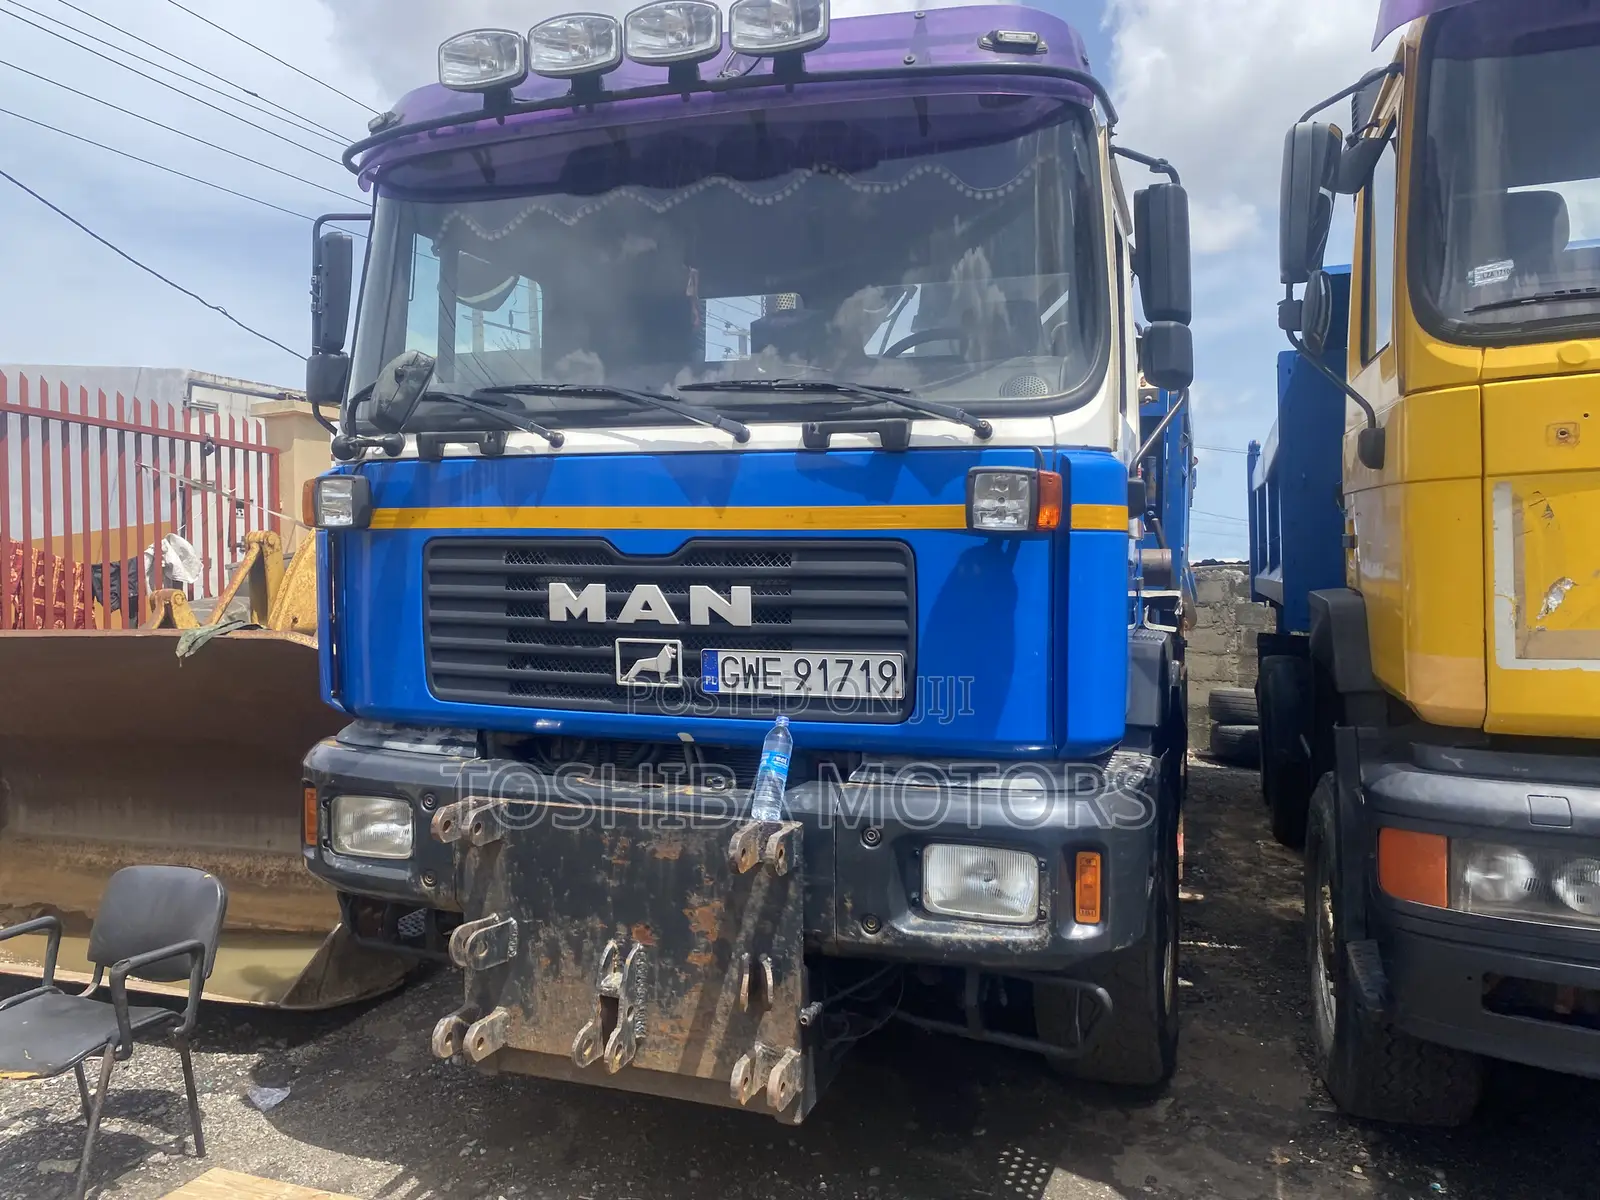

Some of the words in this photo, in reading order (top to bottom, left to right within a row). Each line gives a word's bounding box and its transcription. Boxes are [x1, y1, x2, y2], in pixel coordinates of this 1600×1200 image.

[549, 583, 752, 626] MAN
[705, 676, 718, 686] PL
[720, 656, 782, 690] GWE
[793, 658, 898, 694] 91719
